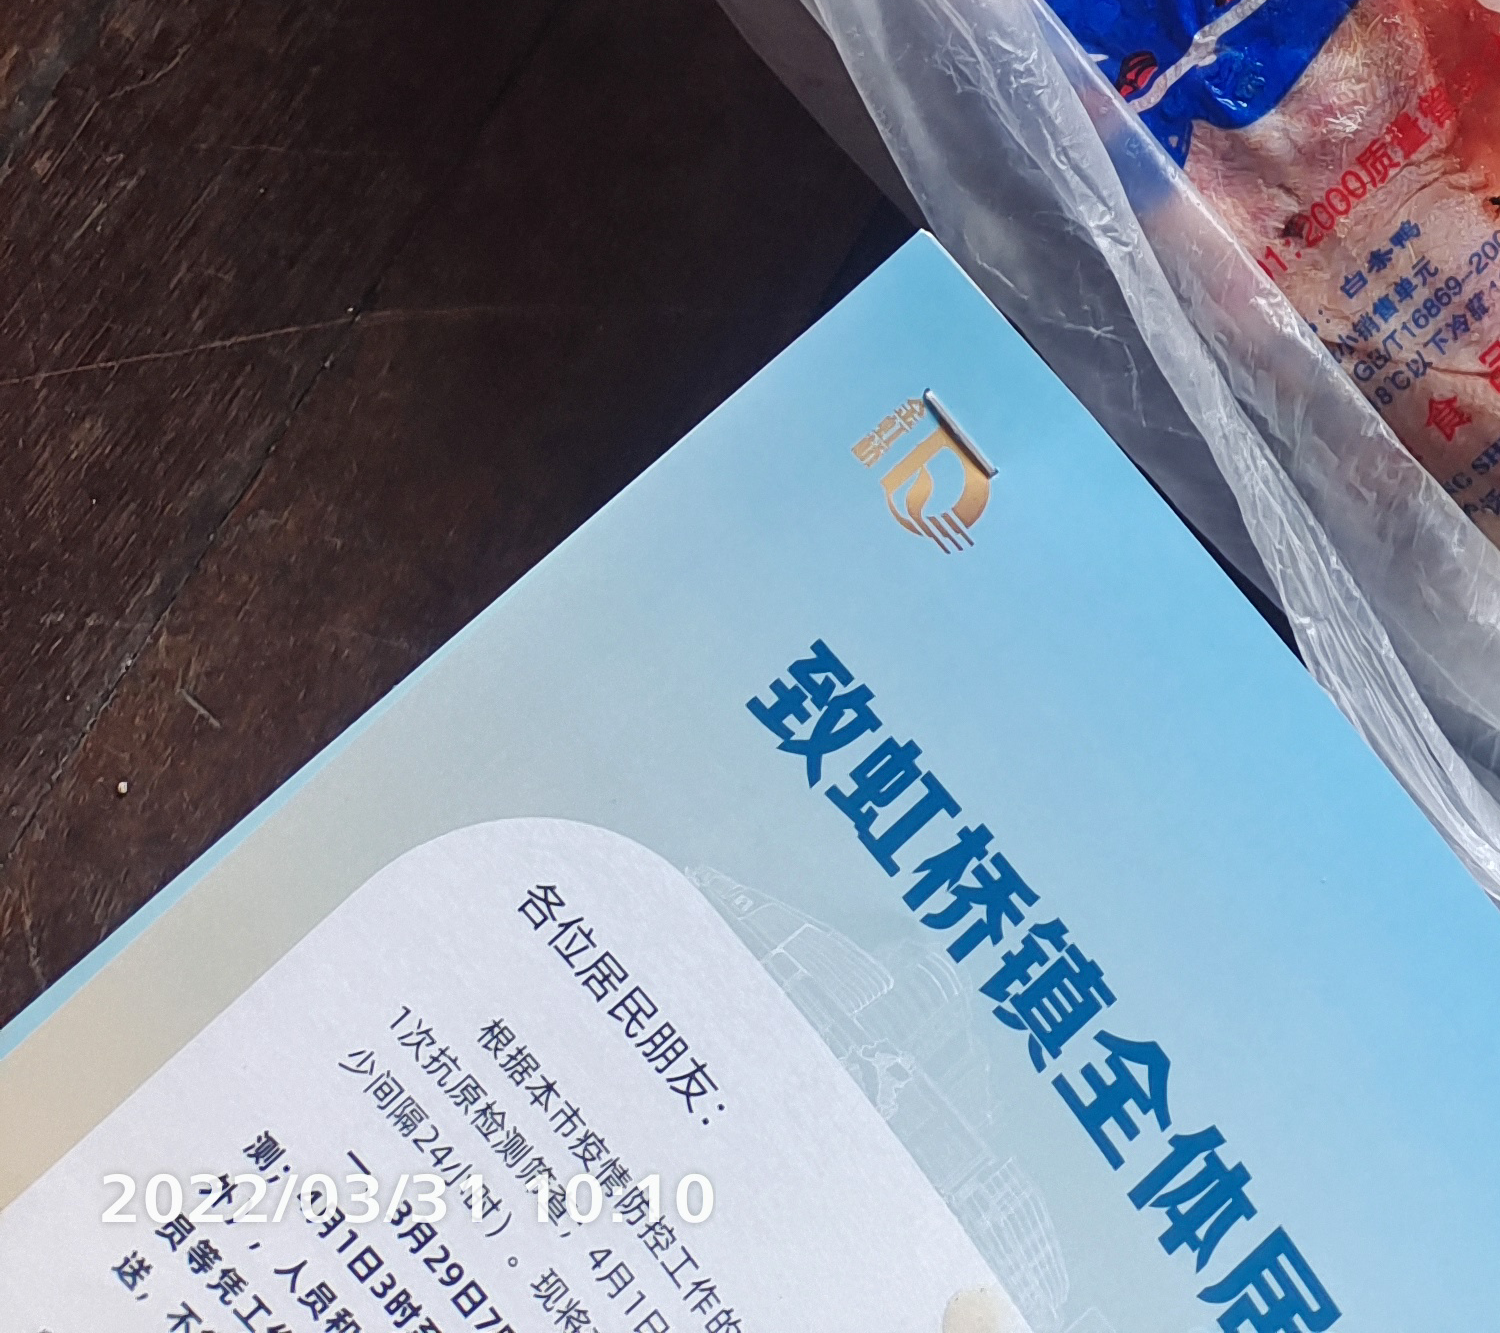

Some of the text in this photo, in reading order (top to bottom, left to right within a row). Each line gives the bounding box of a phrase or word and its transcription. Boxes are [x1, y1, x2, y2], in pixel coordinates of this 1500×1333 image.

[1330, 255, 1439, 363] 小销售单元
[517, 883, 726, 1126] 各位居民朋友：
[745, 638, 1343, 1333] 致虹桥镇全体居
